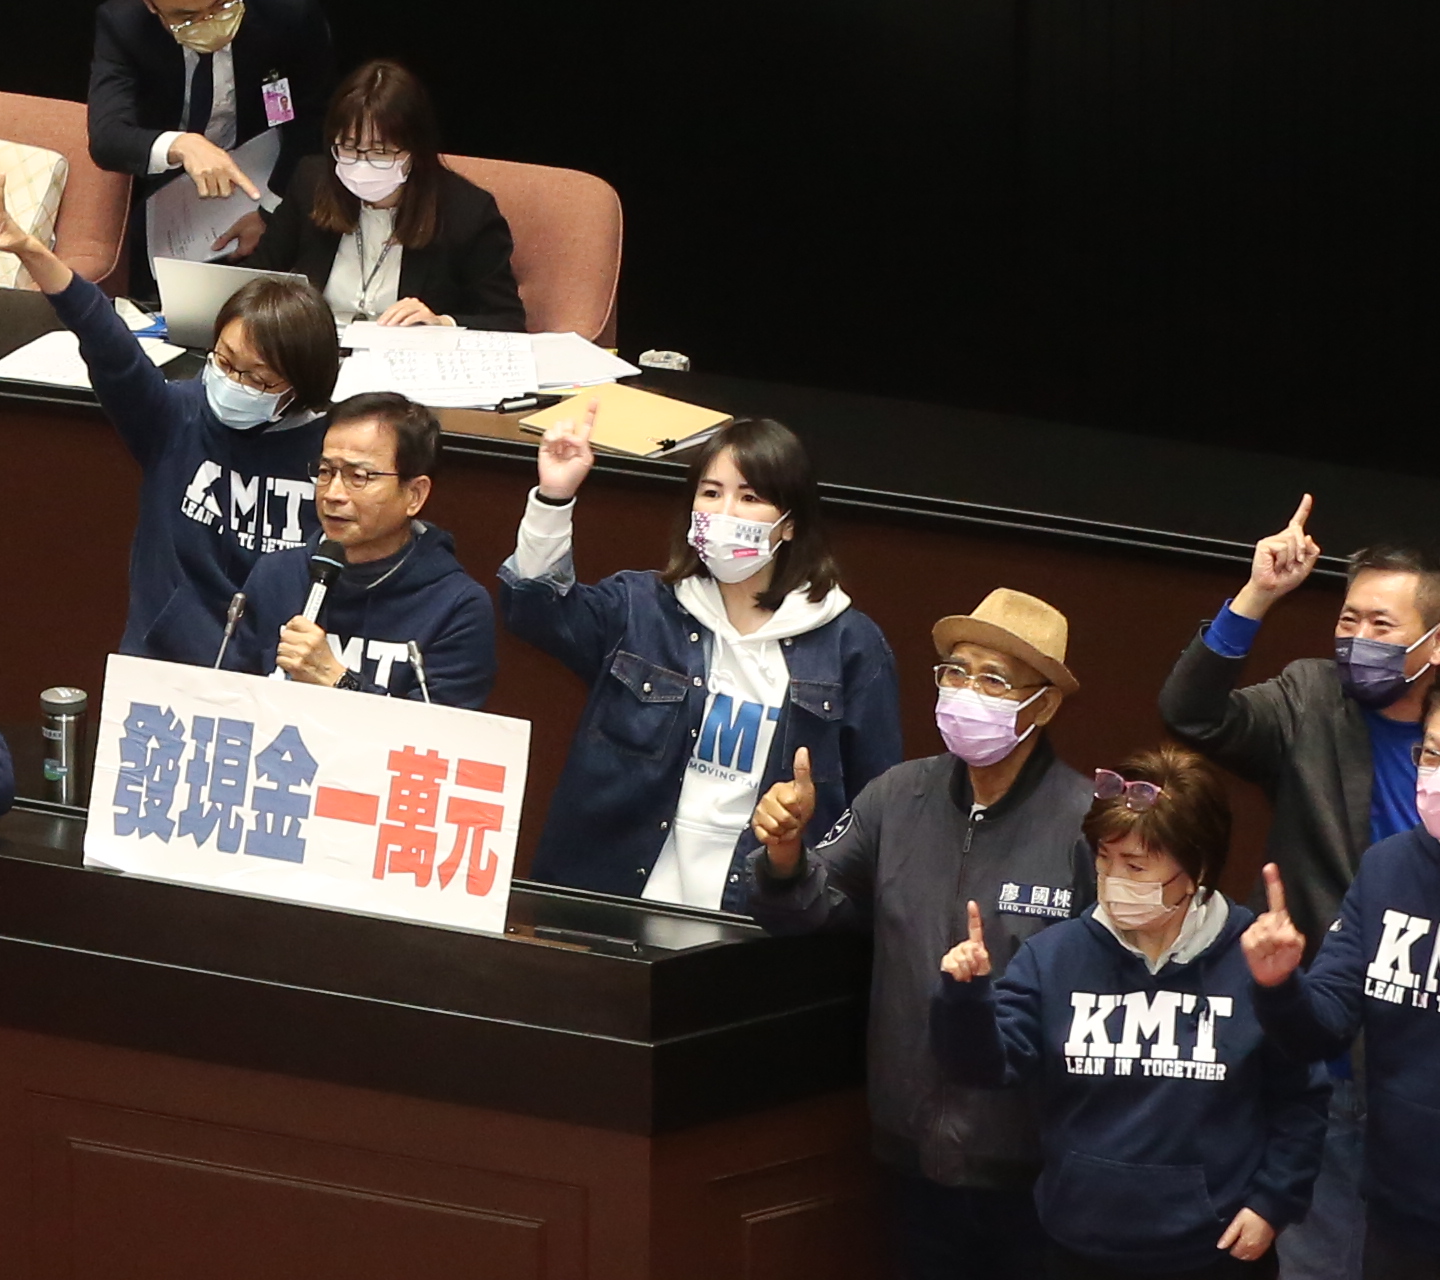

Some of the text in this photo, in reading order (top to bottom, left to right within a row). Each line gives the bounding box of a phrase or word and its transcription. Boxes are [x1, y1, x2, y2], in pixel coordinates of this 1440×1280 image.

[180, 496, 215, 526] LEAN
[687, 760, 737, 782] MOVING
[113, 701, 503, 898] 發現金一萬元
[1363, 977, 1406, 1005] LEAN
[1411, 989, 1429, 1009] IN
[1063, 989, 1234, 1063] KMT
[1064, 1056, 1228, 1082] LEAN IN TOGETHER
